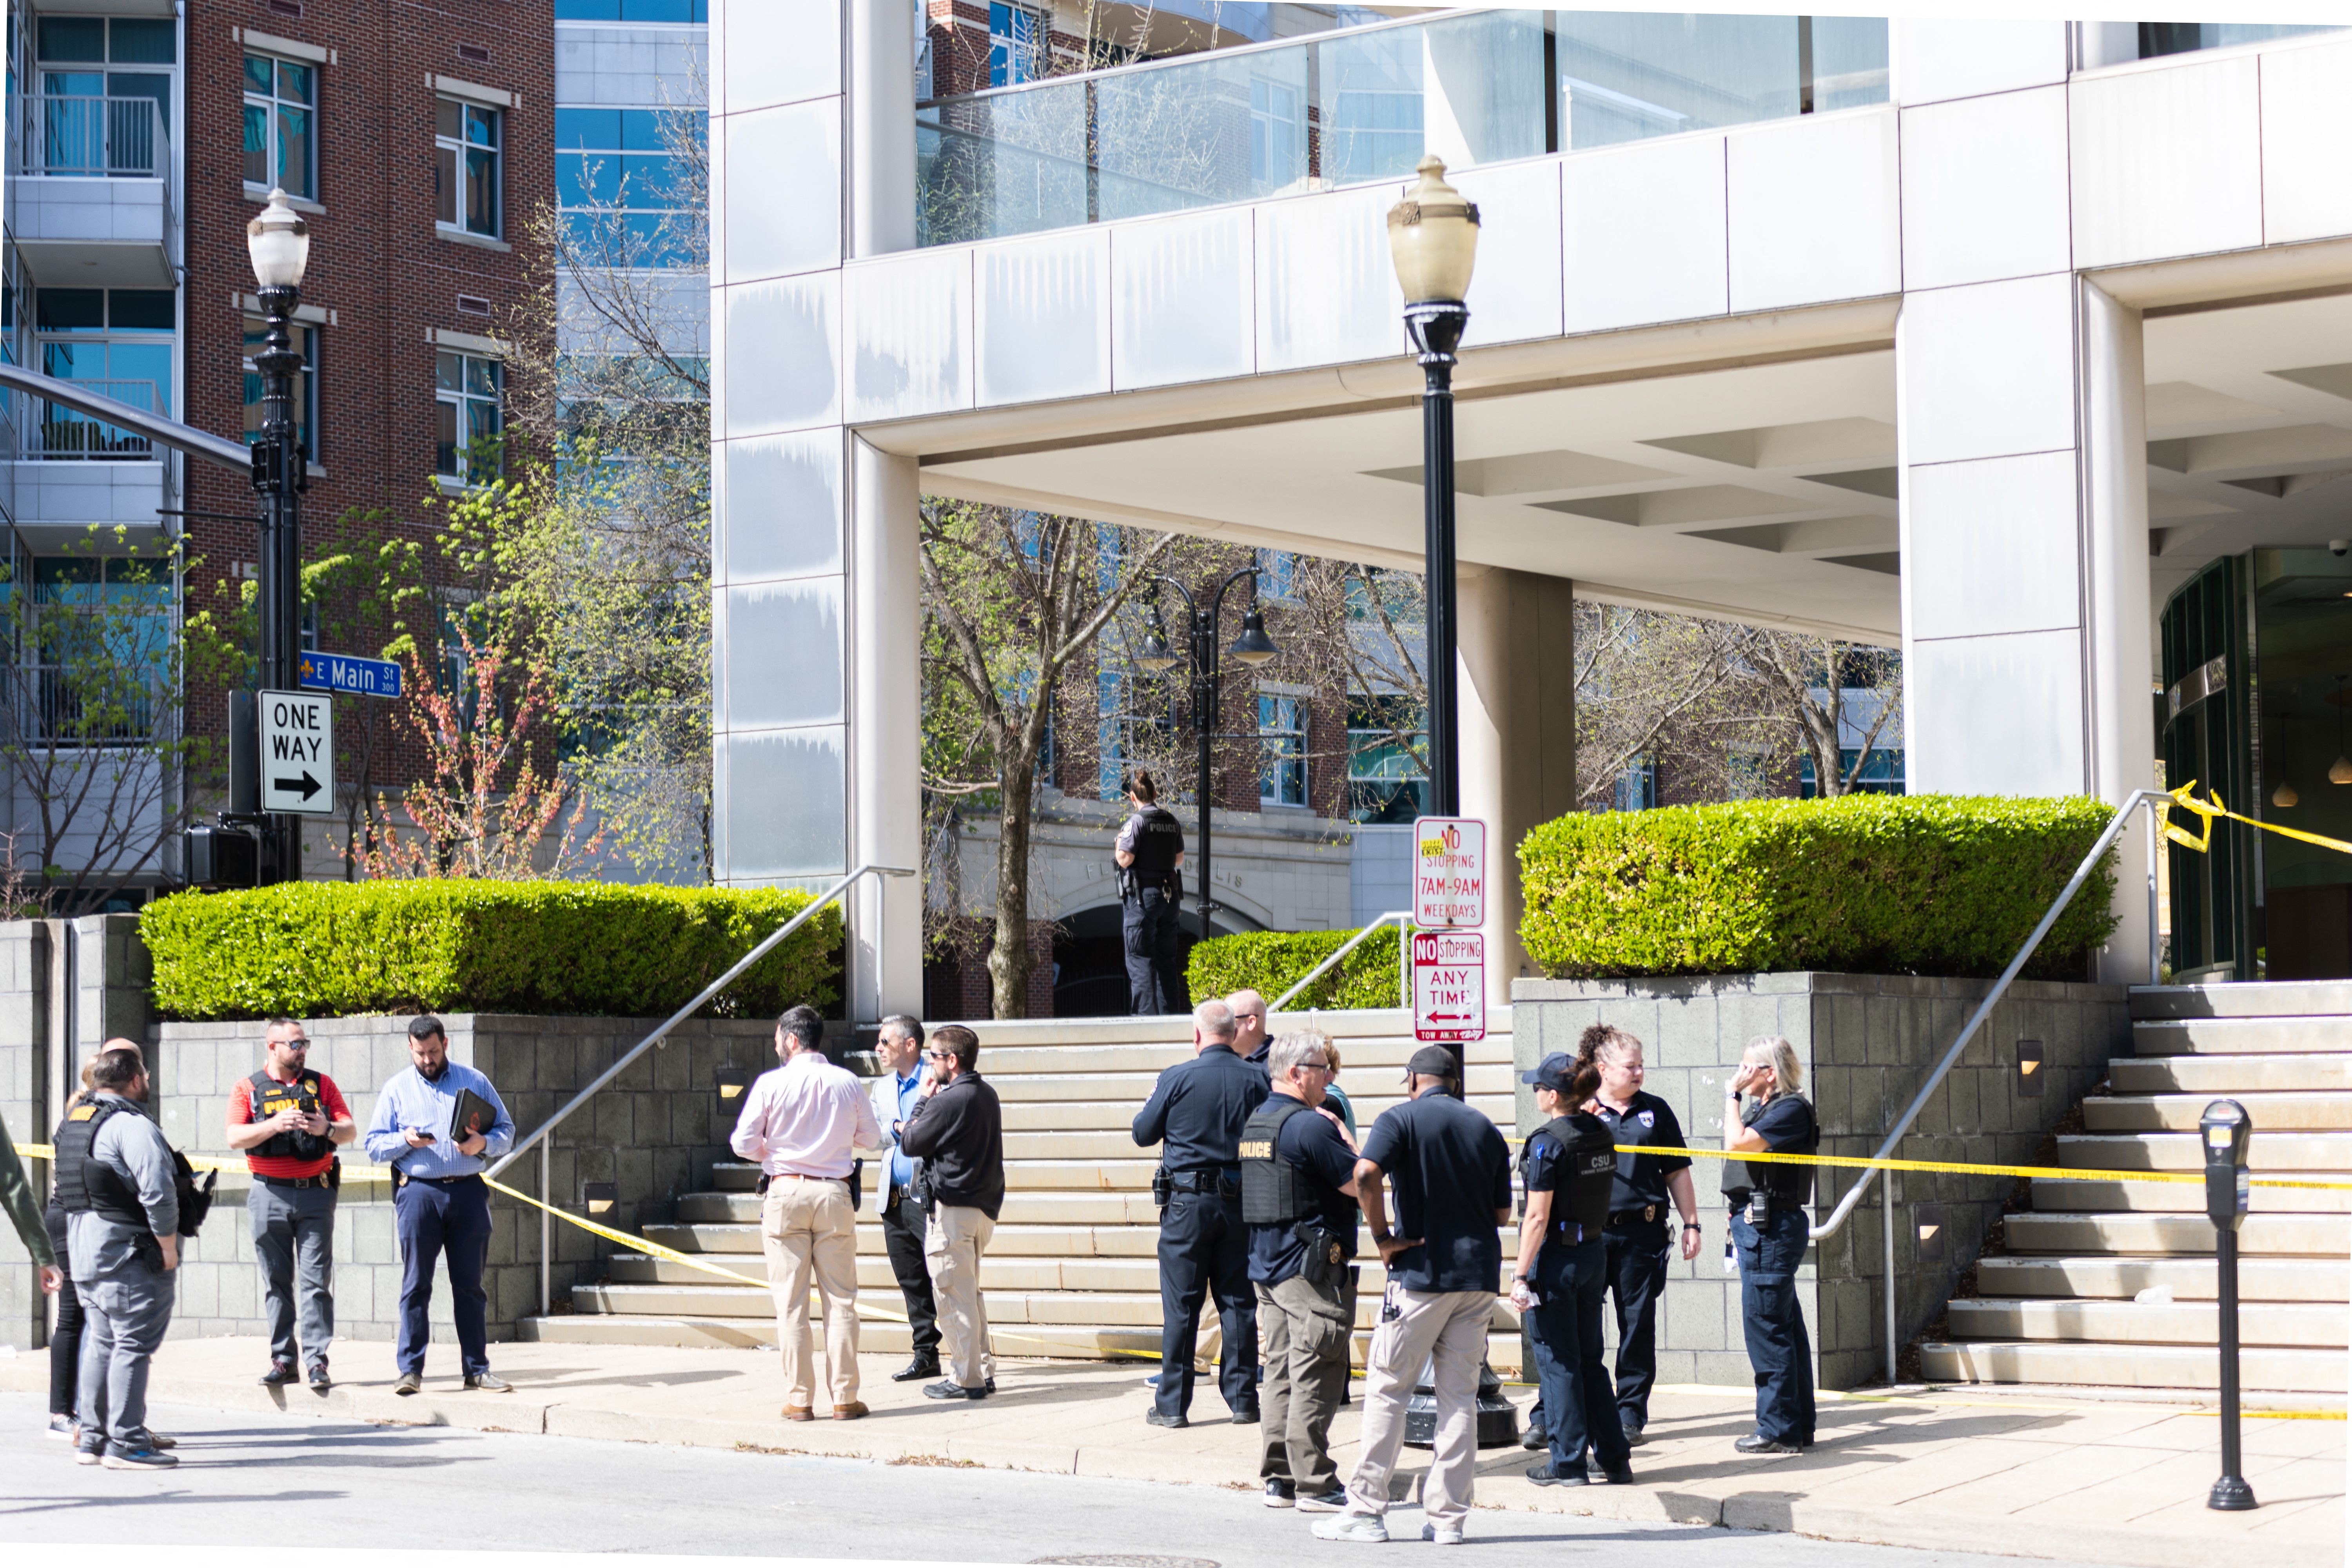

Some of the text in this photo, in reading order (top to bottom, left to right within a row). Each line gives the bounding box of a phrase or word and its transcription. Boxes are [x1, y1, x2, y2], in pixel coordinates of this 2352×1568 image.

[317, 659, 394, 690] E Main St
[382, 682, 395, 692] 300
[274, 702, 320, 730] ONE
[273, 734, 322, 762] WAY
[1150, 823, 1176, 833] POLICE
[1441, 830, 1461, 849] NO
[1427, 855, 1474, 868] STOPPING
[1216, 863, 1242, 887] LIS
[1421, 878, 1480, 896] 7AM-9AM
[1424, 904, 1476, 918] WEEKDAYS
[1416, 940, 1481, 960] NO STOPPING
[1431, 971, 1468, 985] ANY
[1430, 990, 1470, 1005] TIME
[1239, 1141, 1271, 1158] POLICE
[1592, 1154, 1610, 1168] CSU
